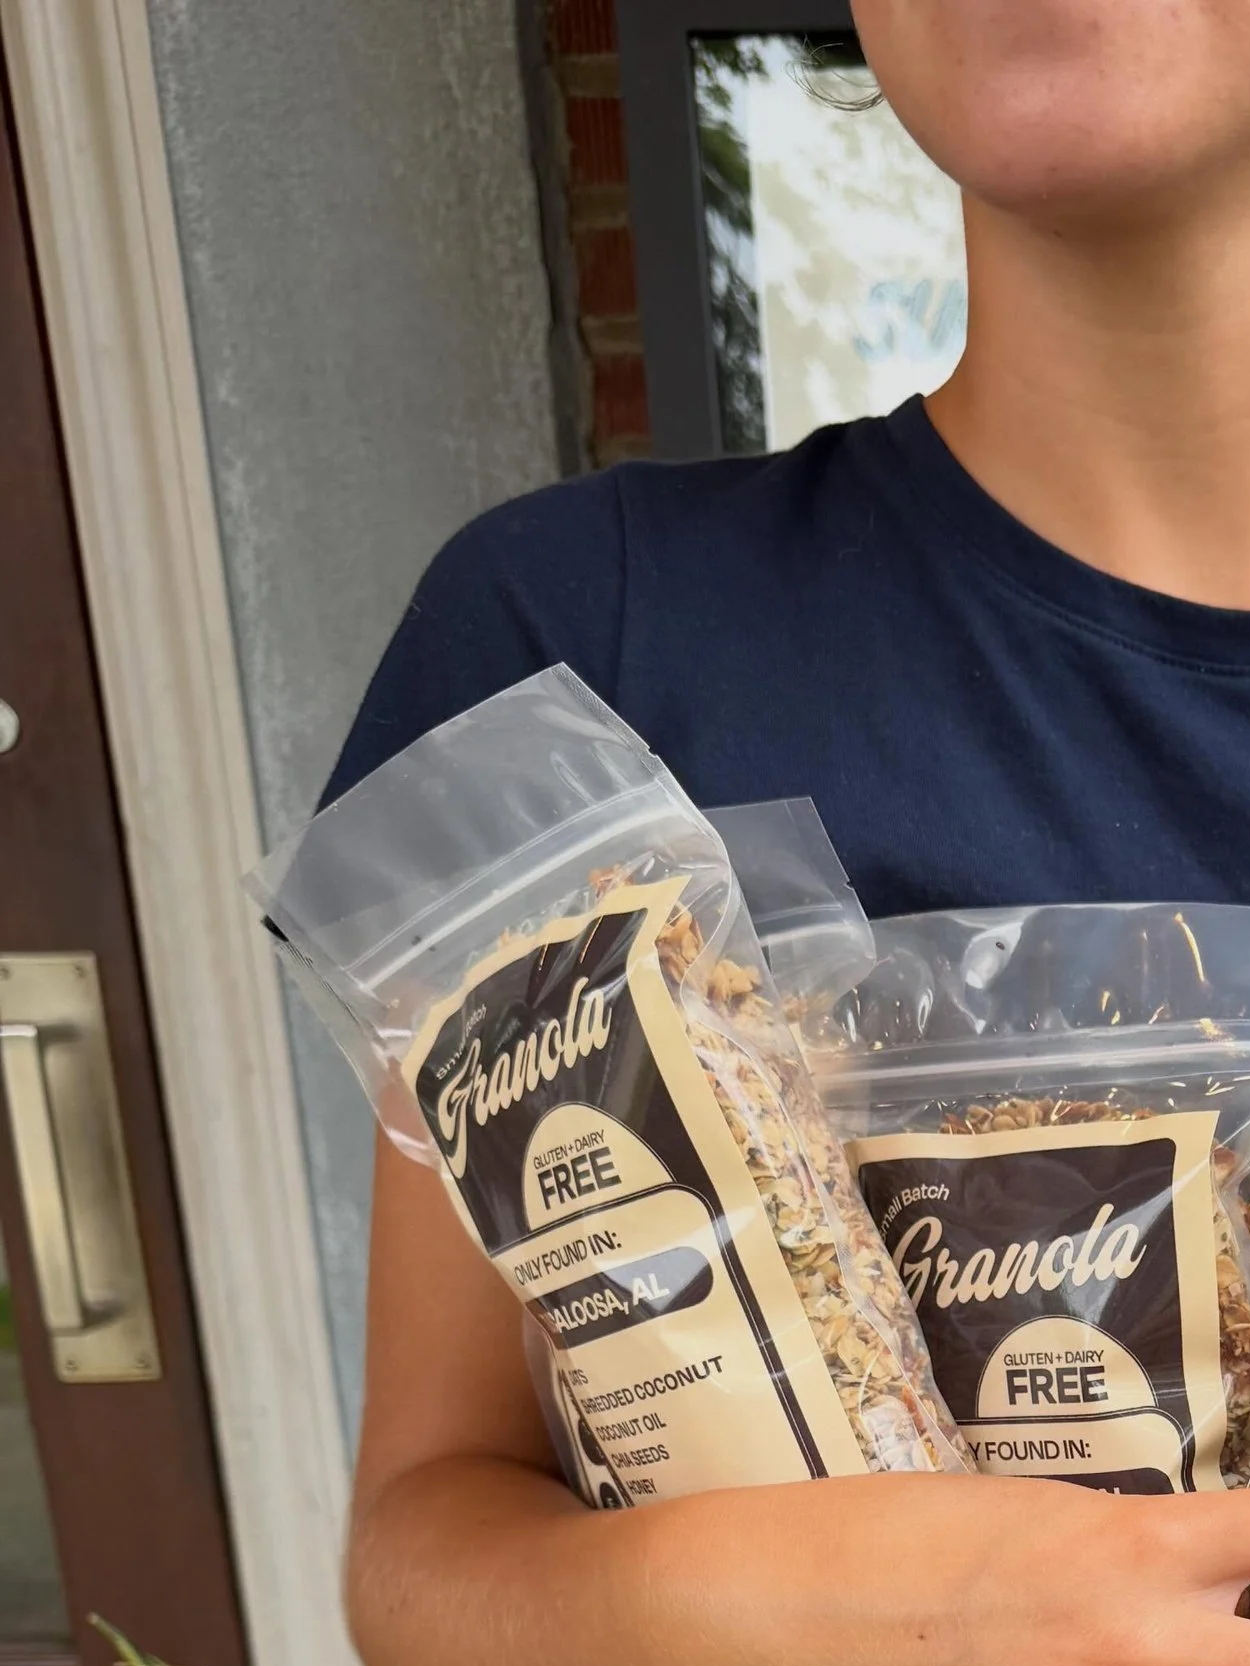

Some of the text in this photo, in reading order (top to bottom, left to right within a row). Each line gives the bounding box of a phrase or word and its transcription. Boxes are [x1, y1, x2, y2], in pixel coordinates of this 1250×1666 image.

[437, 977, 613, 1179] Granola
[533, 1145, 569, 1170] GLUTEN
[574, 1129, 606, 1152] DAIRY
[536, 1146, 622, 1211] FREE
[901, 1183, 950, 1207] Batch
[514, 1230, 622, 1286] ONLY FOUND IN:
[891, 1203, 1147, 1312] Granola
[632, 1272, 670, 1307] AL
[1003, 1351, 1054, 1367] GLUTEN
[1065, 1349, 1105, 1365] DAIRY
[580, 1355, 724, 1416] SHREDDED COCONUT
[1005, 1365, 1110, 1406] FREE
[594, 1412, 667, 1442] COCONUT OIL
[611, 1444, 670, 1469] CHIA SEEDS
[986, 1439, 1060, 1461] FOUND
[1064, 1439, 1092, 1459] IN:
[626, 1478, 658, 1496] HONEY
